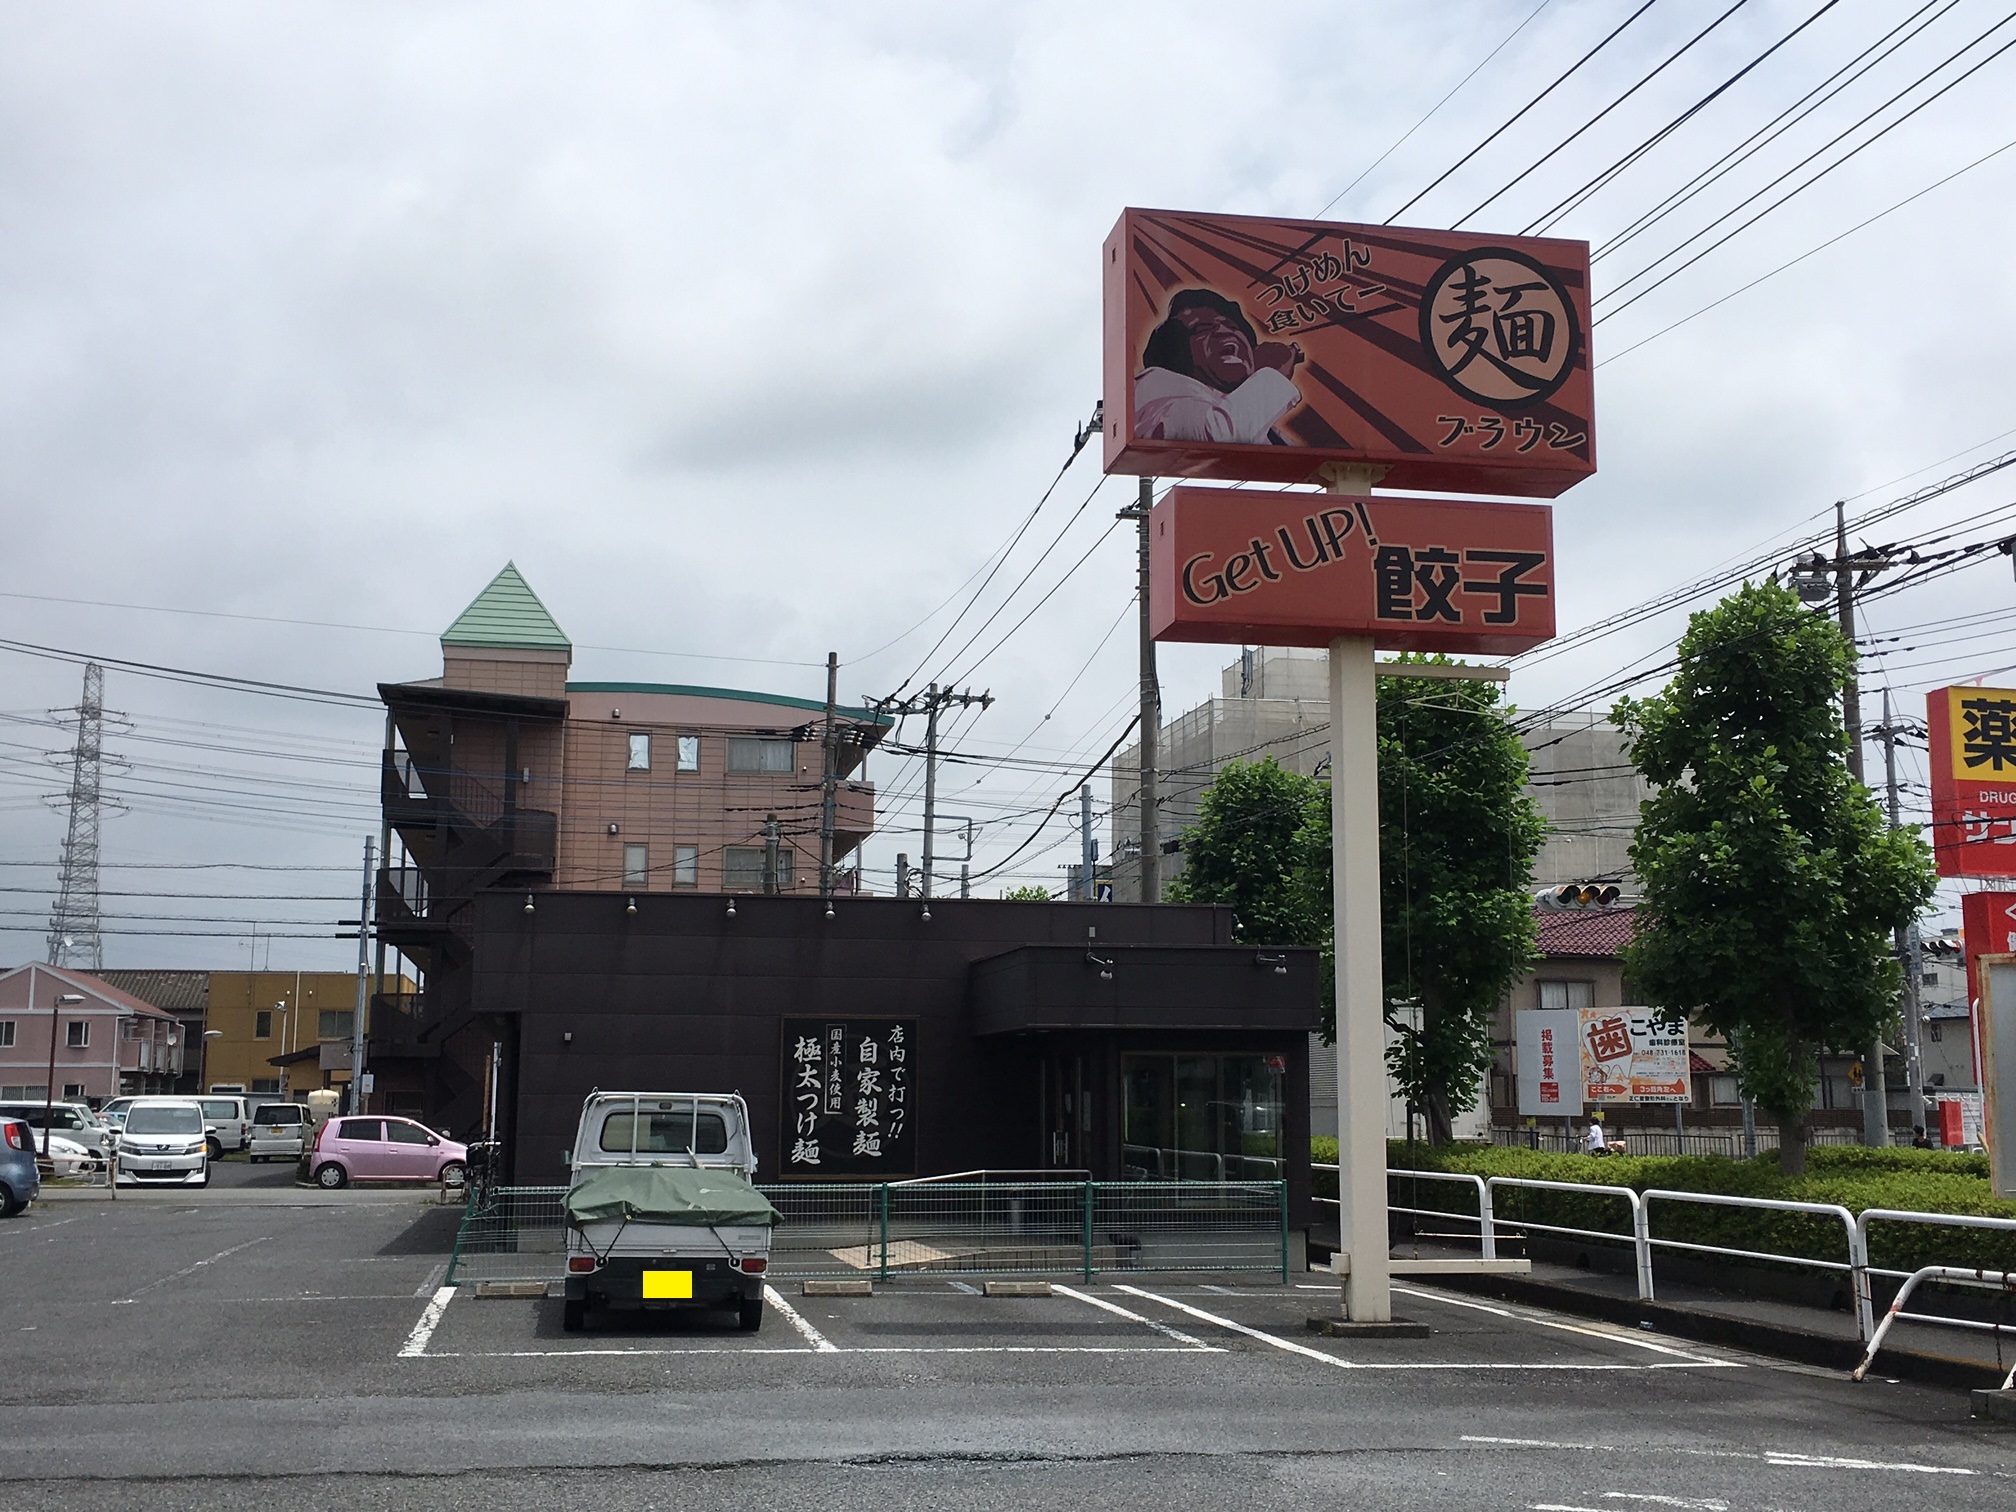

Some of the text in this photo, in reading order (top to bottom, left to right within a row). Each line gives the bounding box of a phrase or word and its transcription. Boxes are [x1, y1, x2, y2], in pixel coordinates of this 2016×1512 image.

[1255, 238, 1372, 308] つけめん
[1265, 283, 1387, 334] 食いてー
[1438, 264, 1558, 392] 麺
[1436, 414, 1587, 454] ブラウン
[1182, 502, 1381, 606] Get UP!
[1373, 545, 1549, 625] 餃子
[1541, 1029, 1554, 1079] 掲載募集
[1587, 1017, 1632, 1063] 歯
[1630, 1018, 1684, 1036] こやま
[791, 1036, 822, 1165] 極太つけ麺
[829, 1028, 843, 1110] 国産小麦使用
[853, 1036, 883, 1157] 自家製麺
